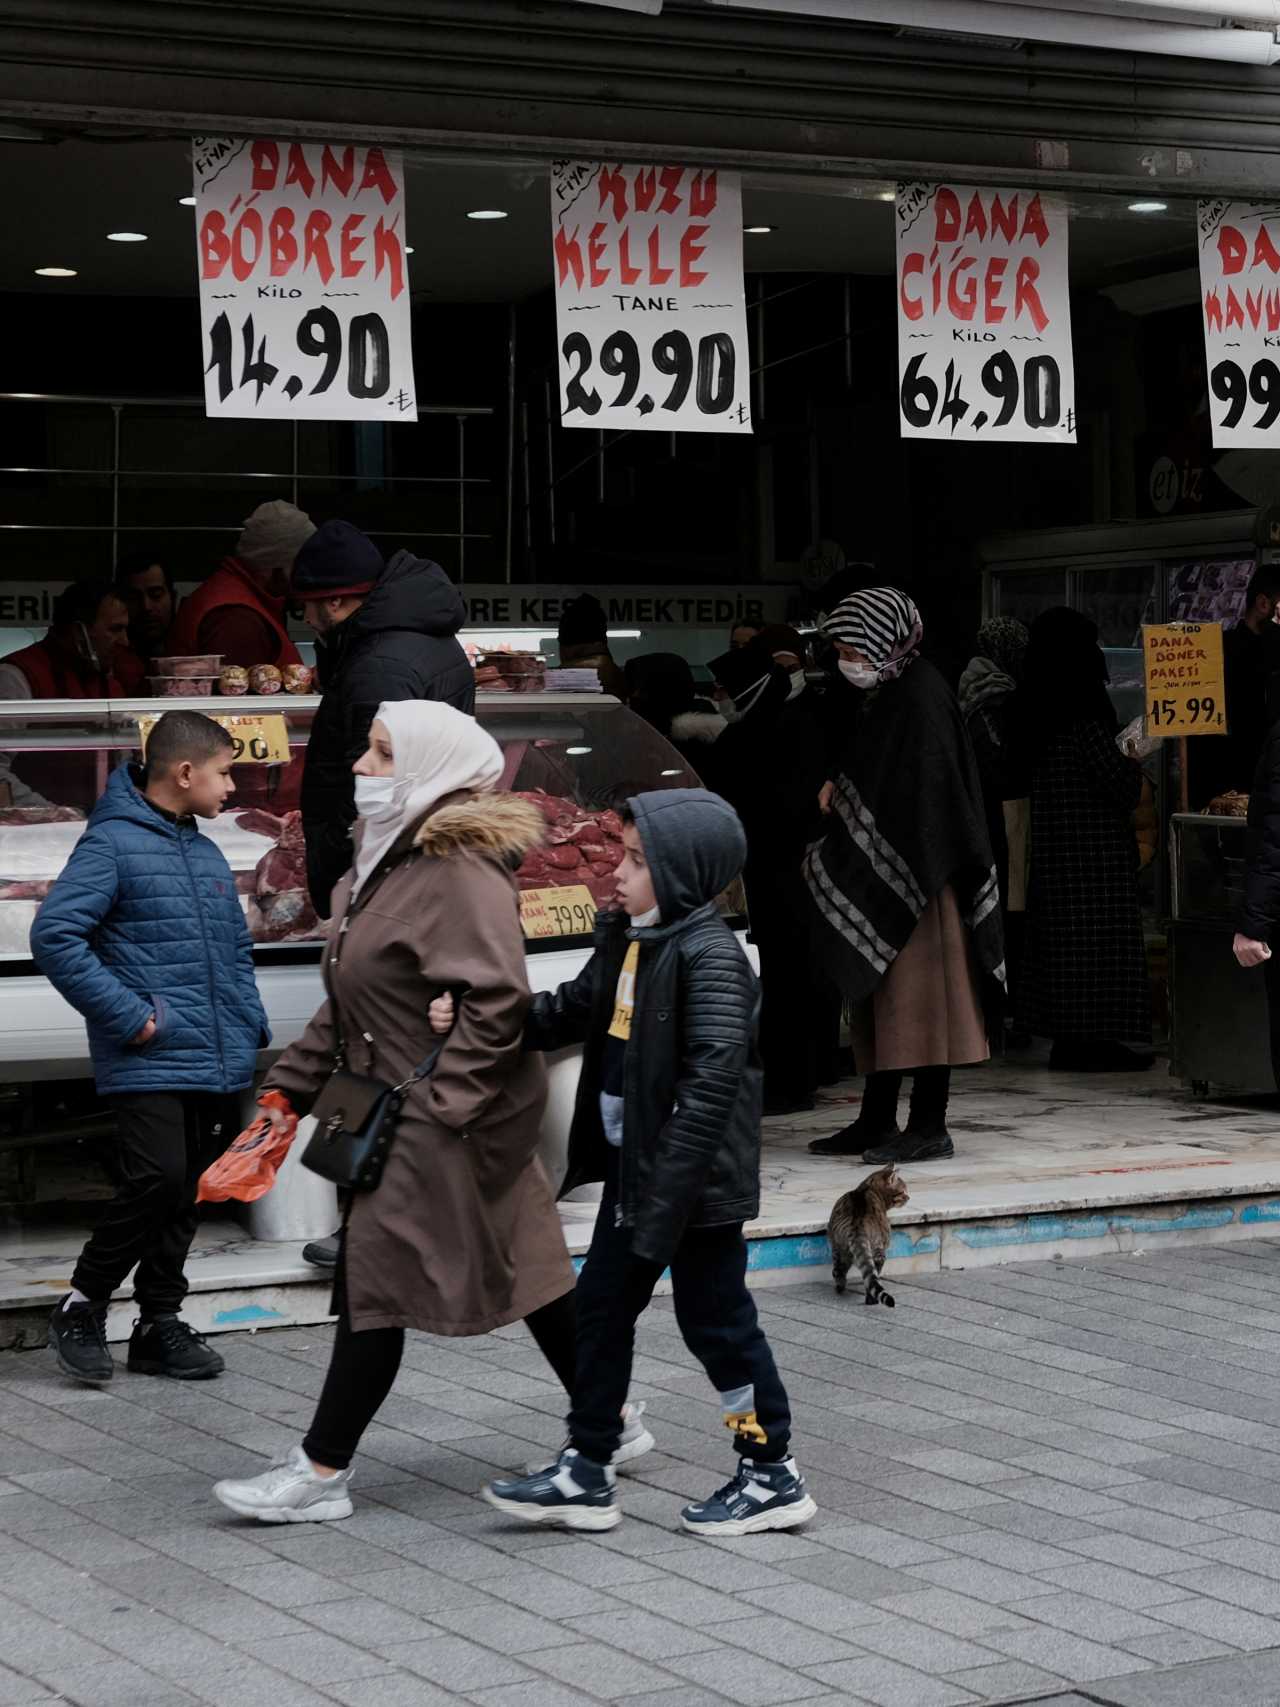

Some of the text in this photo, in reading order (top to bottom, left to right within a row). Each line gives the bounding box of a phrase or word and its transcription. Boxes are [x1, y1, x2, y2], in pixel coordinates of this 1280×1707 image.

[250, 140, 397, 205] DANA
[599, 163, 718, 221] KUZU
[200, 192, 404, 301] BÖBREK
[934, 188, 1050, 248] DANA
[555, 222, 712, 292] KELLE
[257, 285, 302, 299] KİLO
[615, 295, 680, 312] TANE
[205, 305, 391, 406] 14.90
[953, 327, 997, 344] KİLO
[561, 330, 736, 416] 29.90
[900, 349, 1061, 437] 64.90
[1150, 637, 1194, 649] DANA
[1150, 663, 1200, 680] PAKETİ
[1156, 648, 1208, 662] DÖNER
[1151, 697, 1215, 726] 15.99
